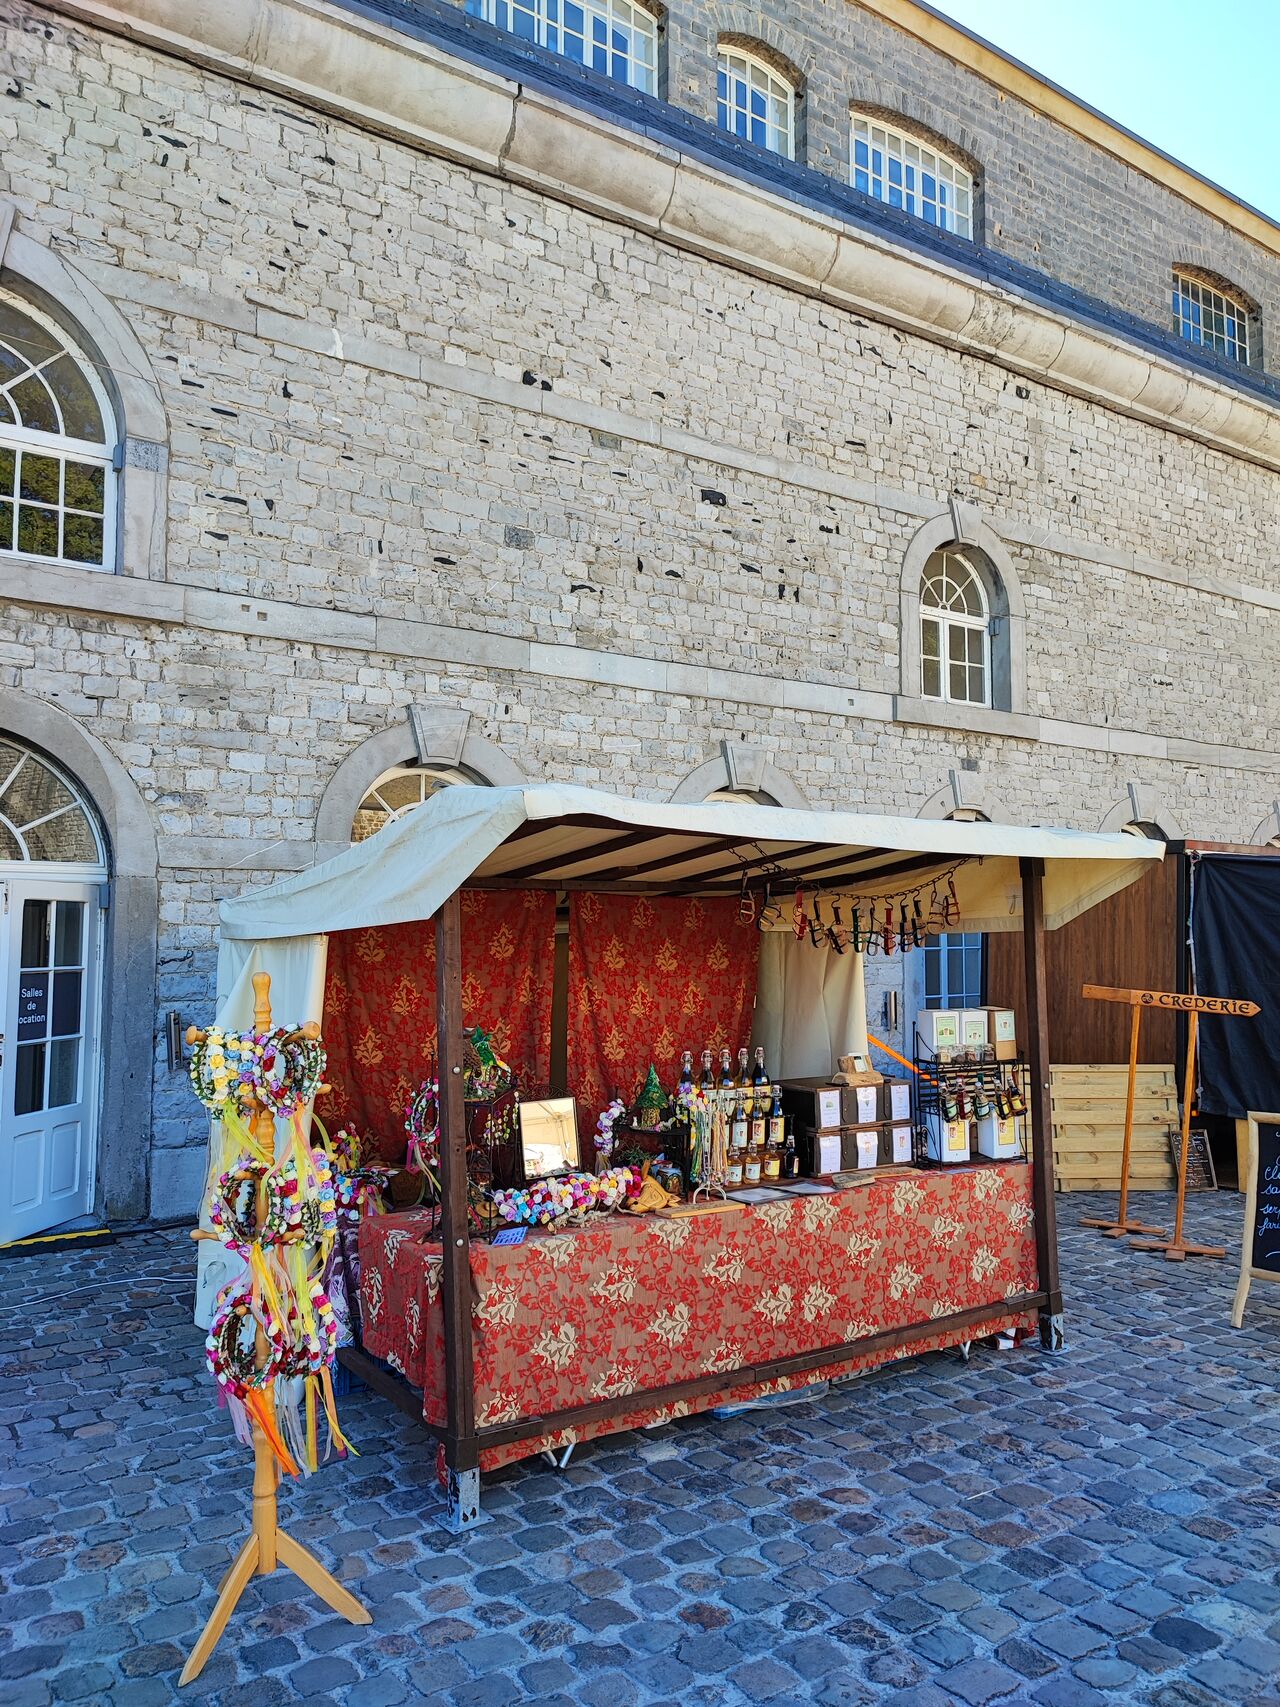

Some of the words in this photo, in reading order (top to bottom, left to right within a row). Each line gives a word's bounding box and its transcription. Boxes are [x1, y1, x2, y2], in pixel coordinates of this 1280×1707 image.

[21, 988, 43, 998] Salles
[27, 1001, 37, 1011] de
[18, 1013, 46, 1024] ocation
